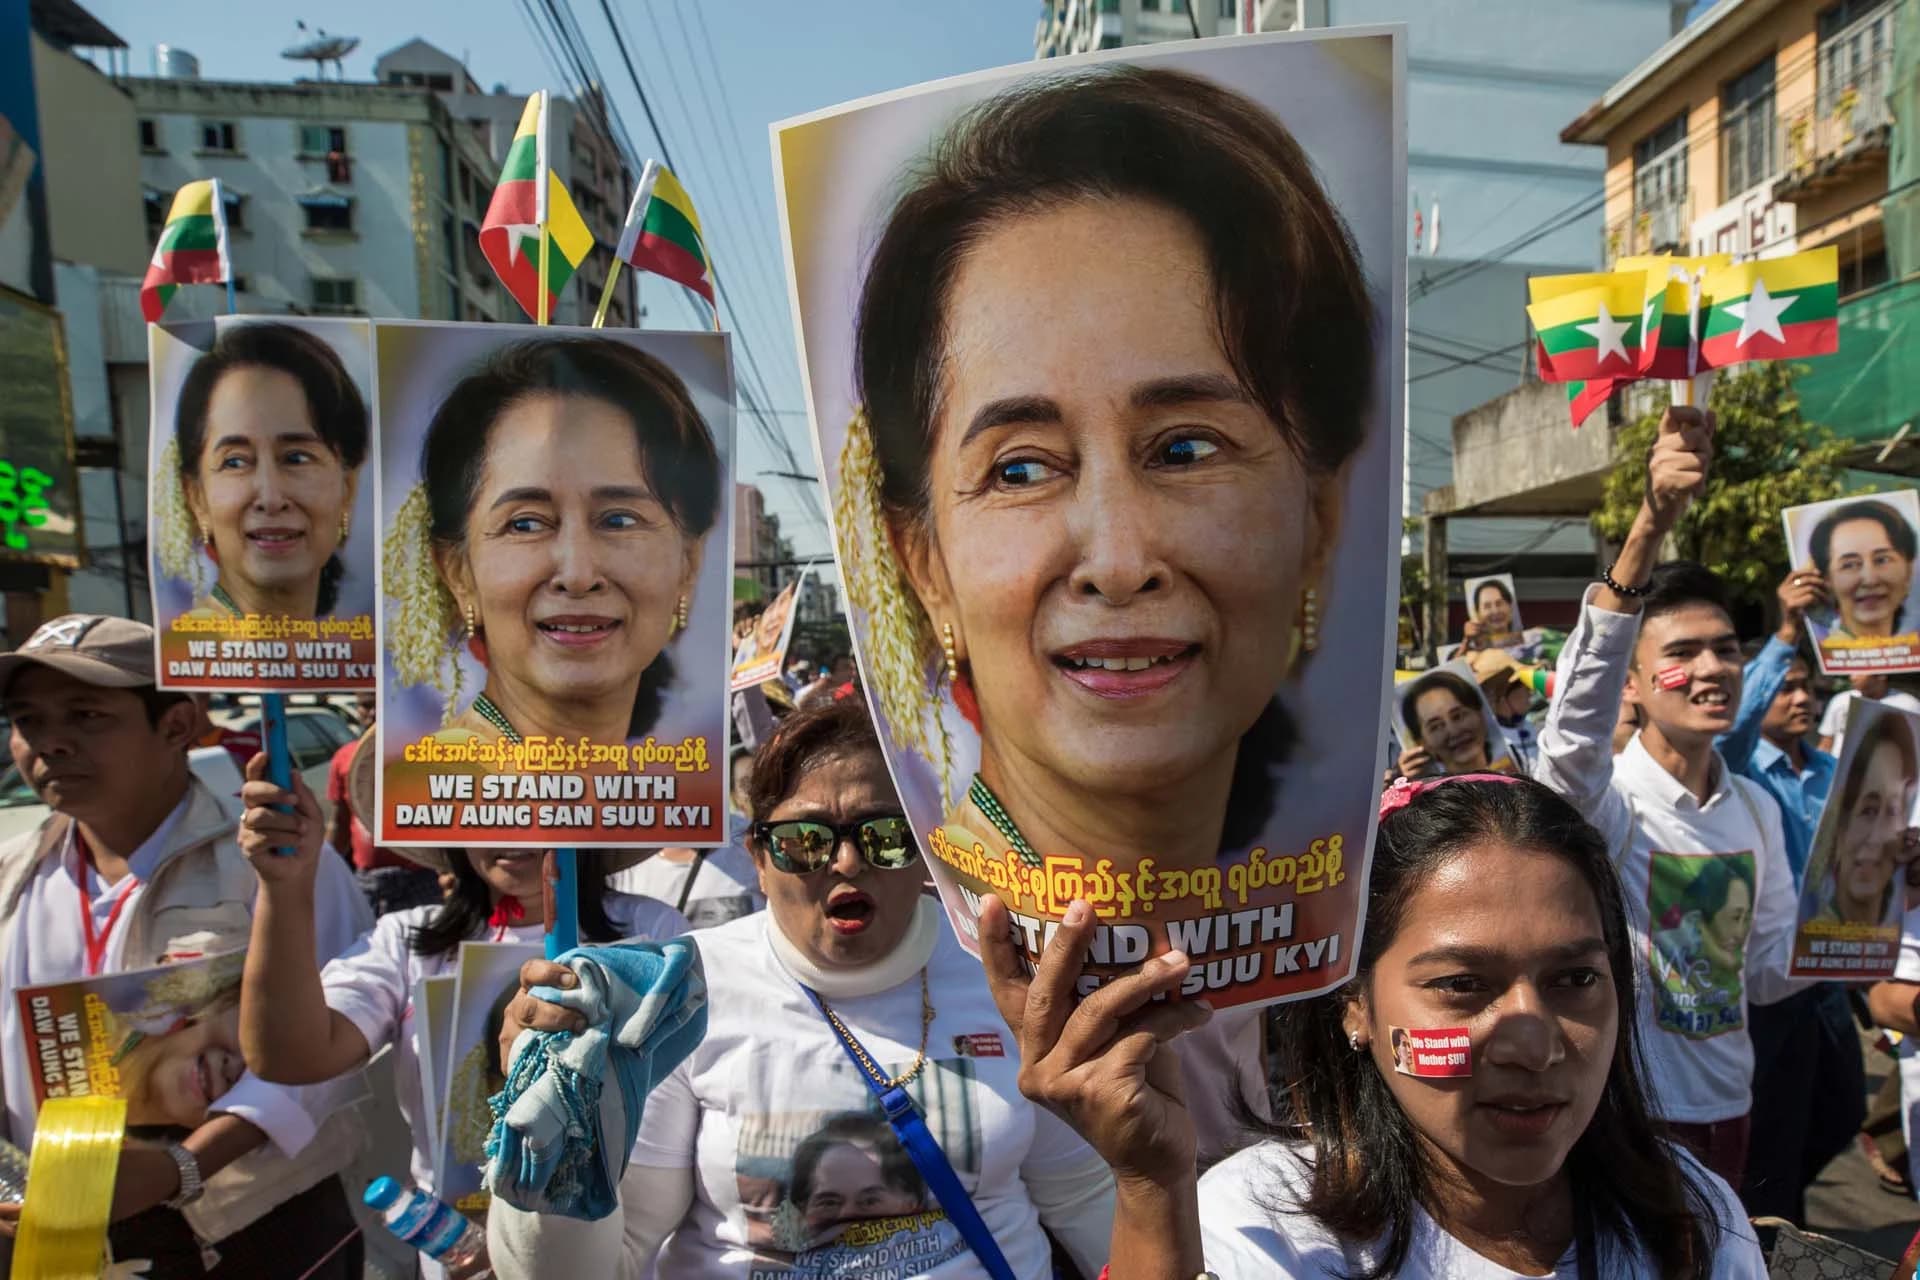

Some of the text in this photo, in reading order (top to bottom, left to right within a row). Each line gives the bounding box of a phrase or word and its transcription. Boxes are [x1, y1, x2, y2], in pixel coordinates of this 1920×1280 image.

[188, 640, 352, 659] WE STAND WITH
[168, 661, 206, 676] DAW
[209, 662, 254, 677] AUNG
[258, 663, 296, 677] SAN
[302, 663, 339, 677] SUU
[428, 774, 675, 799] WE STAND WITH
[396, 804, 710, 826] DAW AUNG SAN SUU KYI
[1166, 903, 1293, 955] WITH
[1181, 952, 1261, 996] SUU
[1274, 934, 1339, 974] KYI
[1656, 947, 1713, 988] We
[31, 995, 55, 1034] DAW
[58, 1012, 91, 1097] WE STAN
[1412, 1035, 1470, 1048] We Stand with
[1418, 1053, 1466, 1066] Mother SUU
[38, 1039, 64, 1084] AUNG
[795, 1234, 939, 1271] WE STAND WITH
